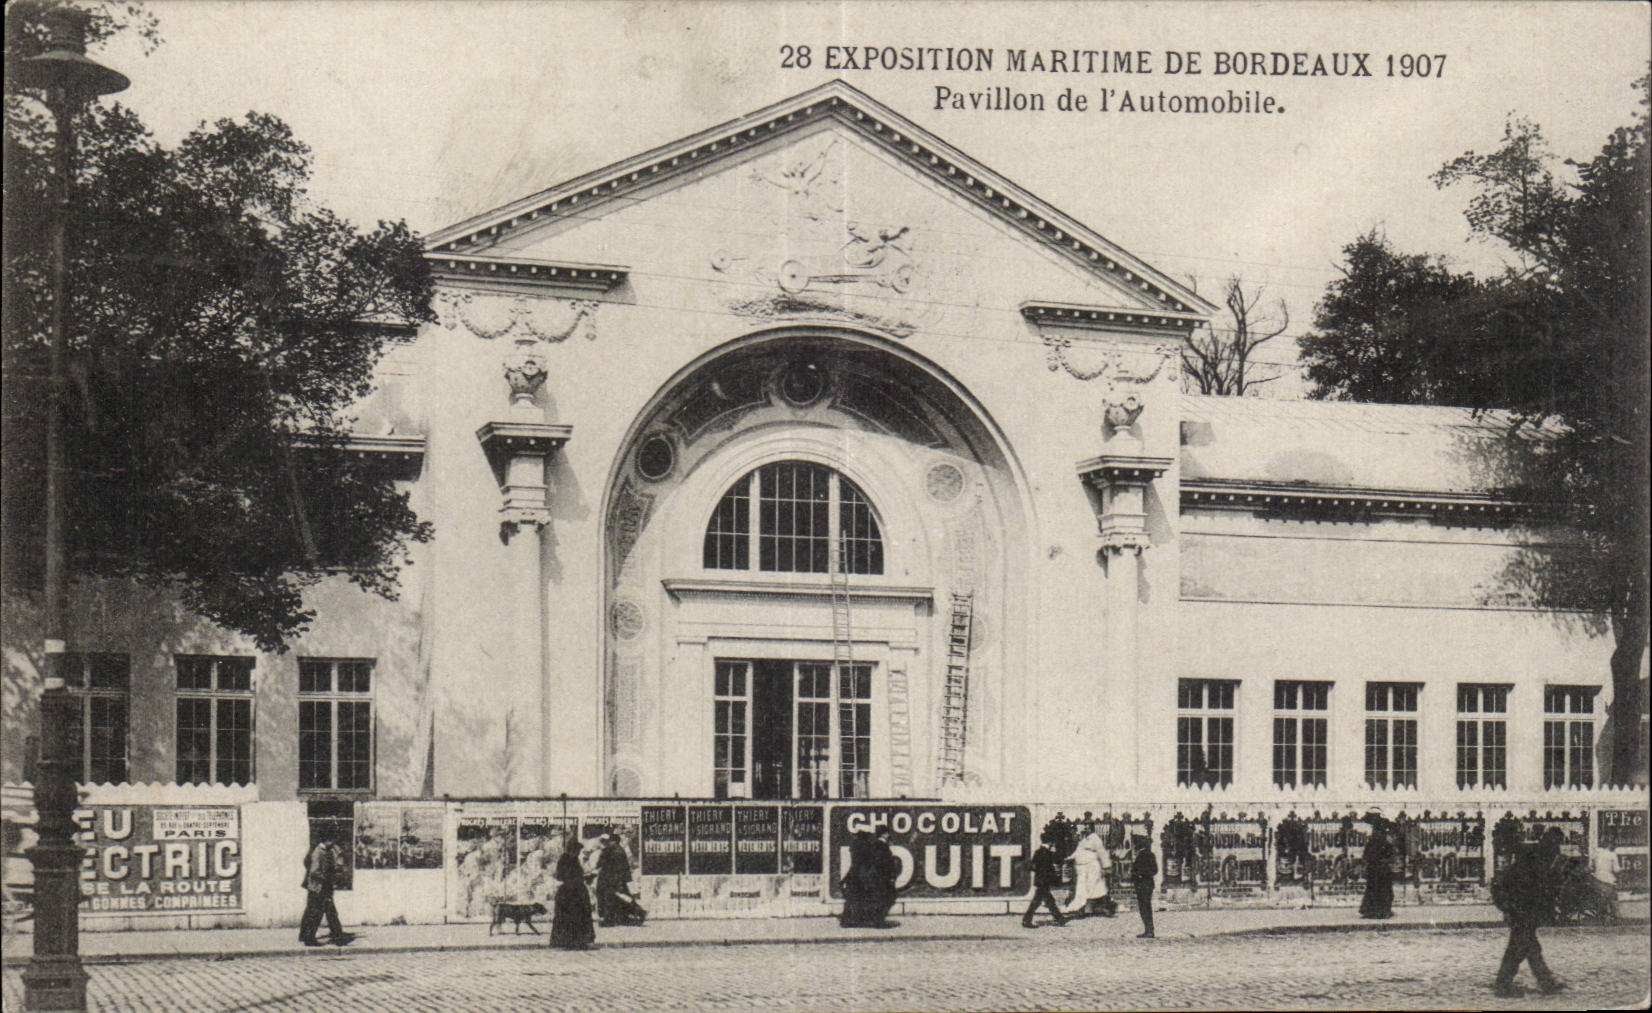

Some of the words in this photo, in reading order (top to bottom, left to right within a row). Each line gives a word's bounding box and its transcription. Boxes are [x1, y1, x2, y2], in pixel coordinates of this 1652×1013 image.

[74, 809, 133, 841] EU
[847, 812, 1016, 834] CHOCOLAT
[1605, 811, 1643, 826] Thé
[165, 830, 226, 838] PARIS
[81, 840, 239, 880] ECTRIC
[1620, 856, 1643, 871] hé
[121, 881, 151, 895] LA
[160, 880, 232, 894] ROUTE
[92, 896, 147, 911] GOMMES
